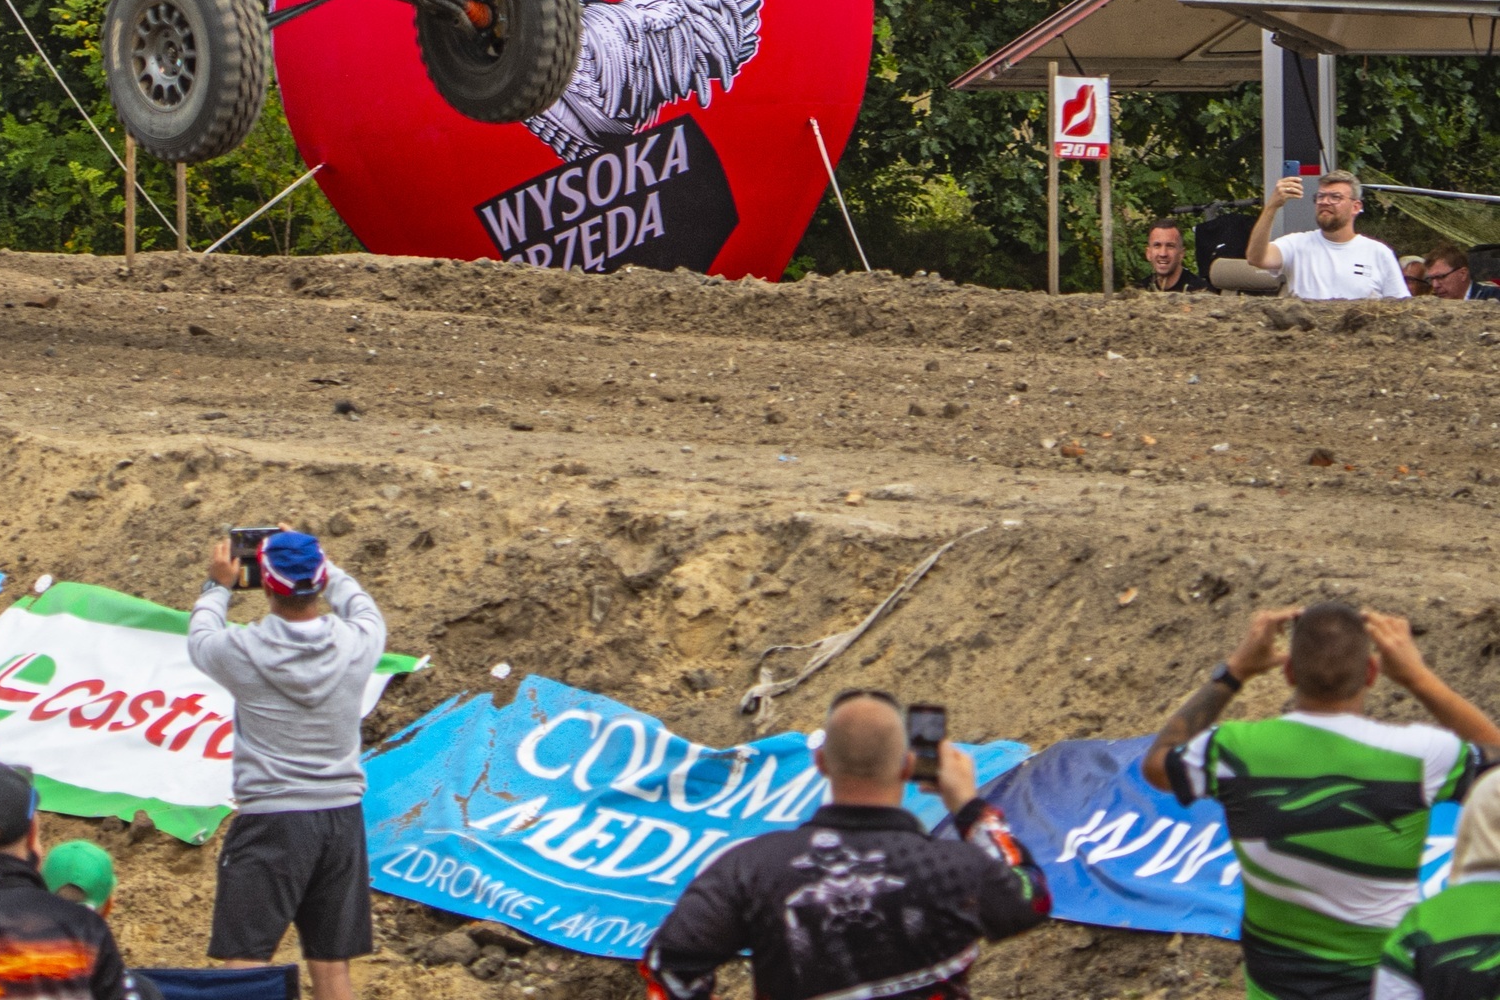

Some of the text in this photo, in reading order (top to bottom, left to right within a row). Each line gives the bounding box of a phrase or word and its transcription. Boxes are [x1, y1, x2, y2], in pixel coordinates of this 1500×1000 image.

[481, 124, 689, 251] WYSOKA
[1060, 143, 1100, 157] 20 m
[382, 846, 544, 919] ZDROWIE
[534, 905, 560, 925] I
